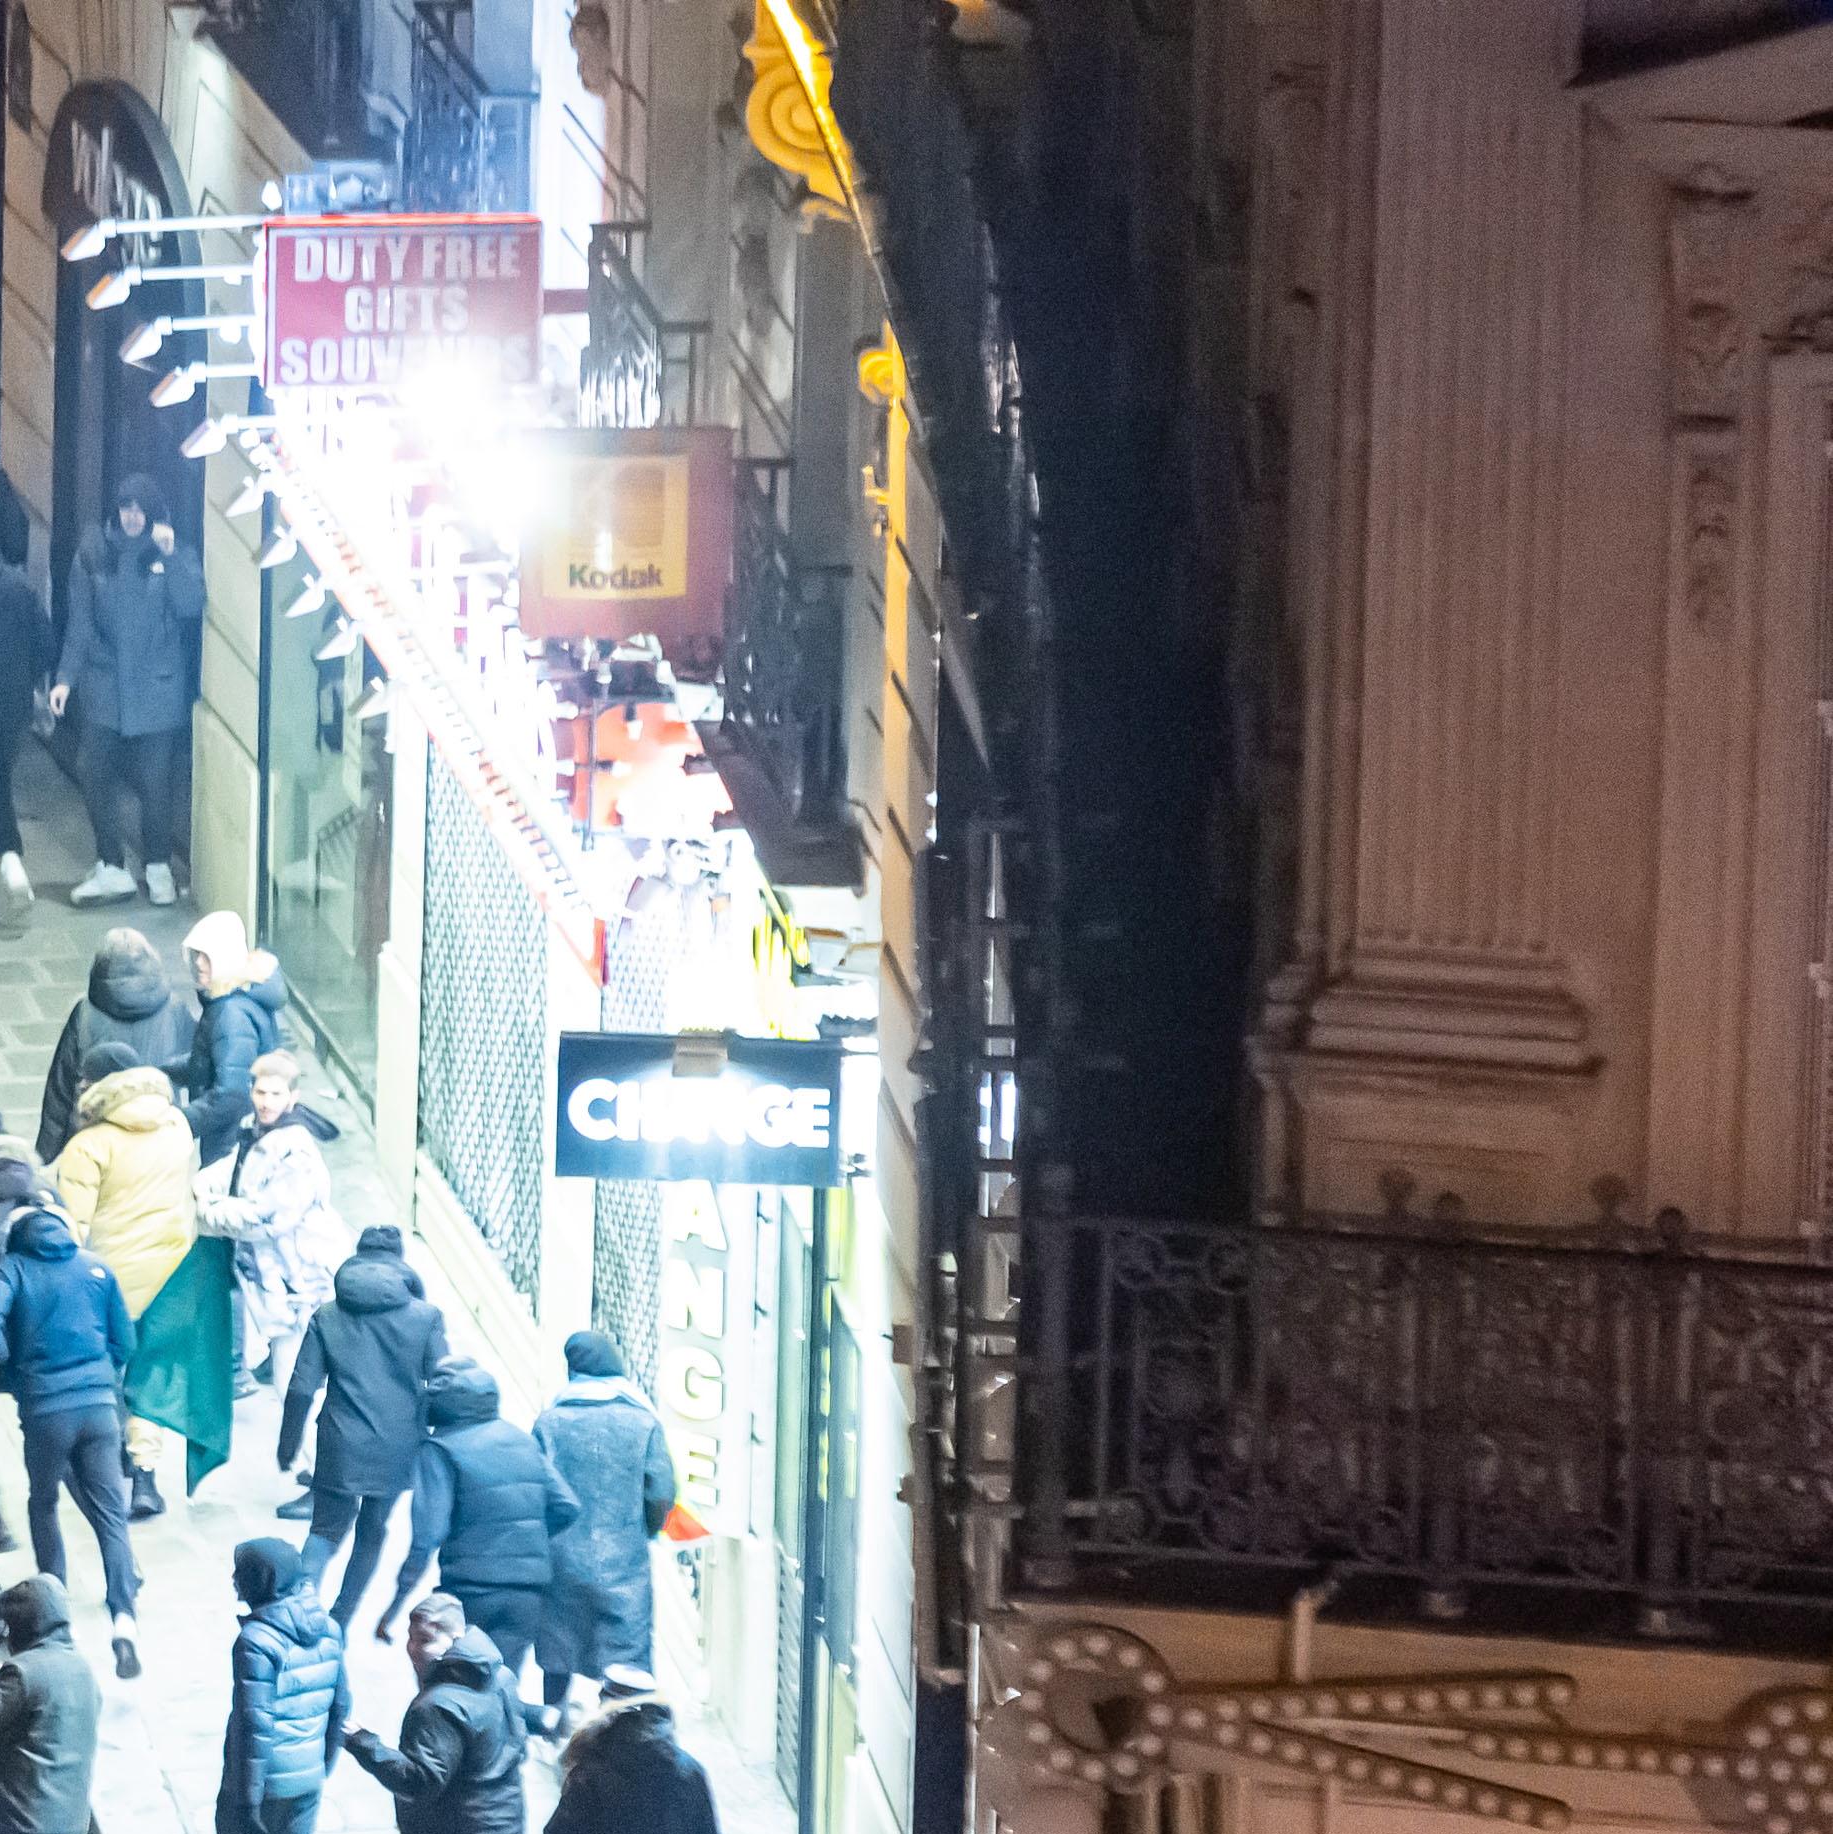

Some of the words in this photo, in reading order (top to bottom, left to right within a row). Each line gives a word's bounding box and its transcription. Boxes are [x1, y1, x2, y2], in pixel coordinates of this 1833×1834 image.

[294, 237, 411, 283] DUTY
[422, 233, 522, 280] FREE
[343, 286, 469, 334] GIFTS
[568, 563, 662, 591] Kodak
